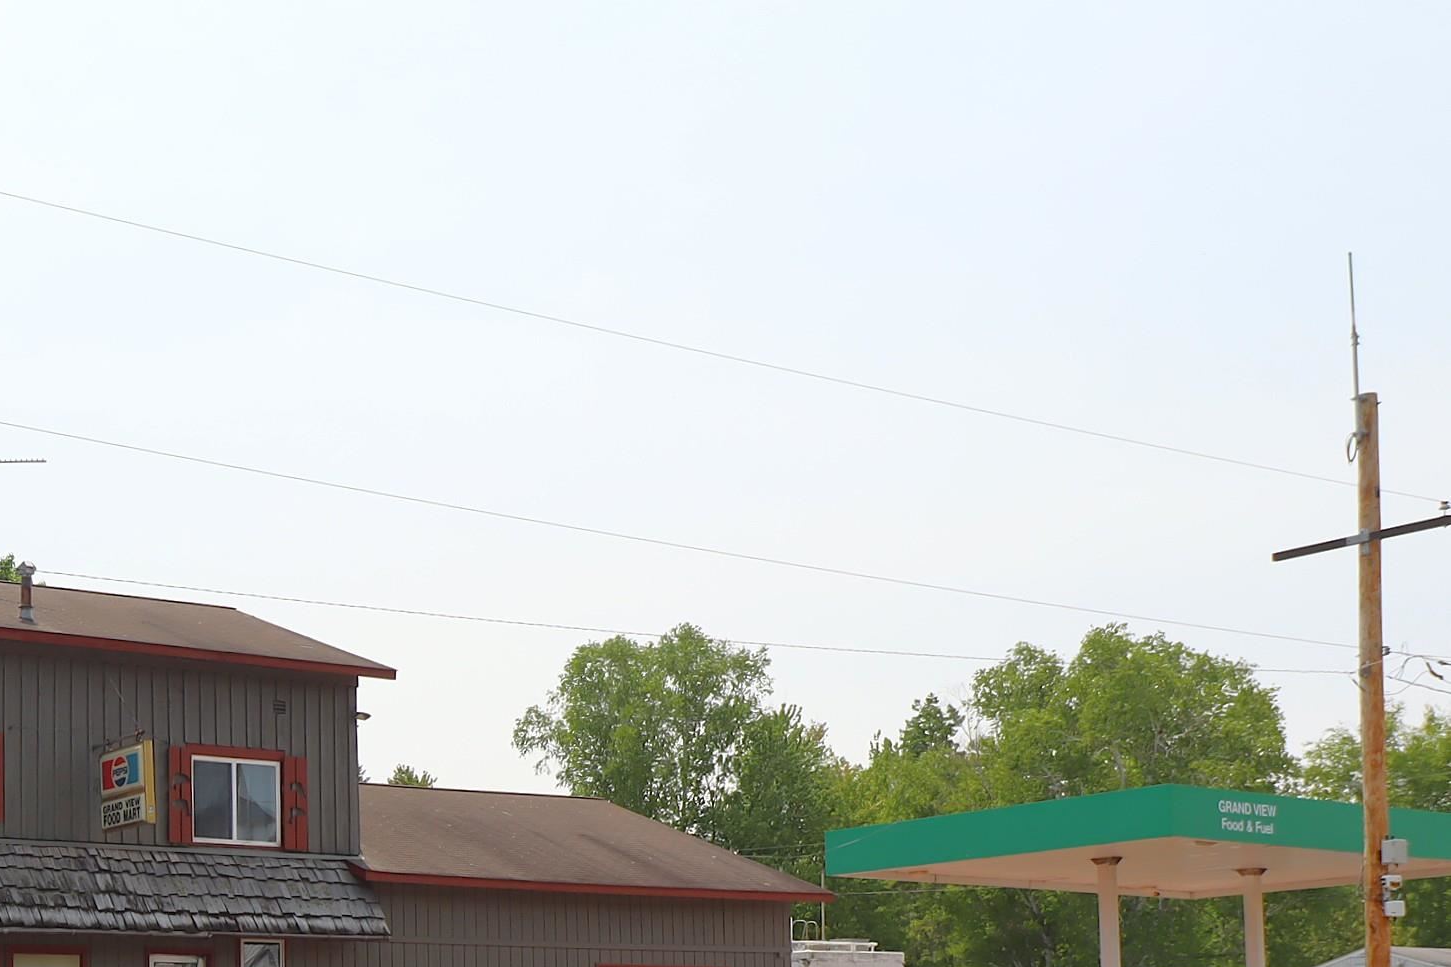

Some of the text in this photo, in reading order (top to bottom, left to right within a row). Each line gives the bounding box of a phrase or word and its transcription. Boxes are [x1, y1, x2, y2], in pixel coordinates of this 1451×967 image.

[102, 797, 141, 814] GRAND VIEW
[1218, 800, 1276, 817] GRAND VIEW
[103, 806, 141, 826] FOOD MART
[1221, 818, 1275, 835] Food & Fuel
